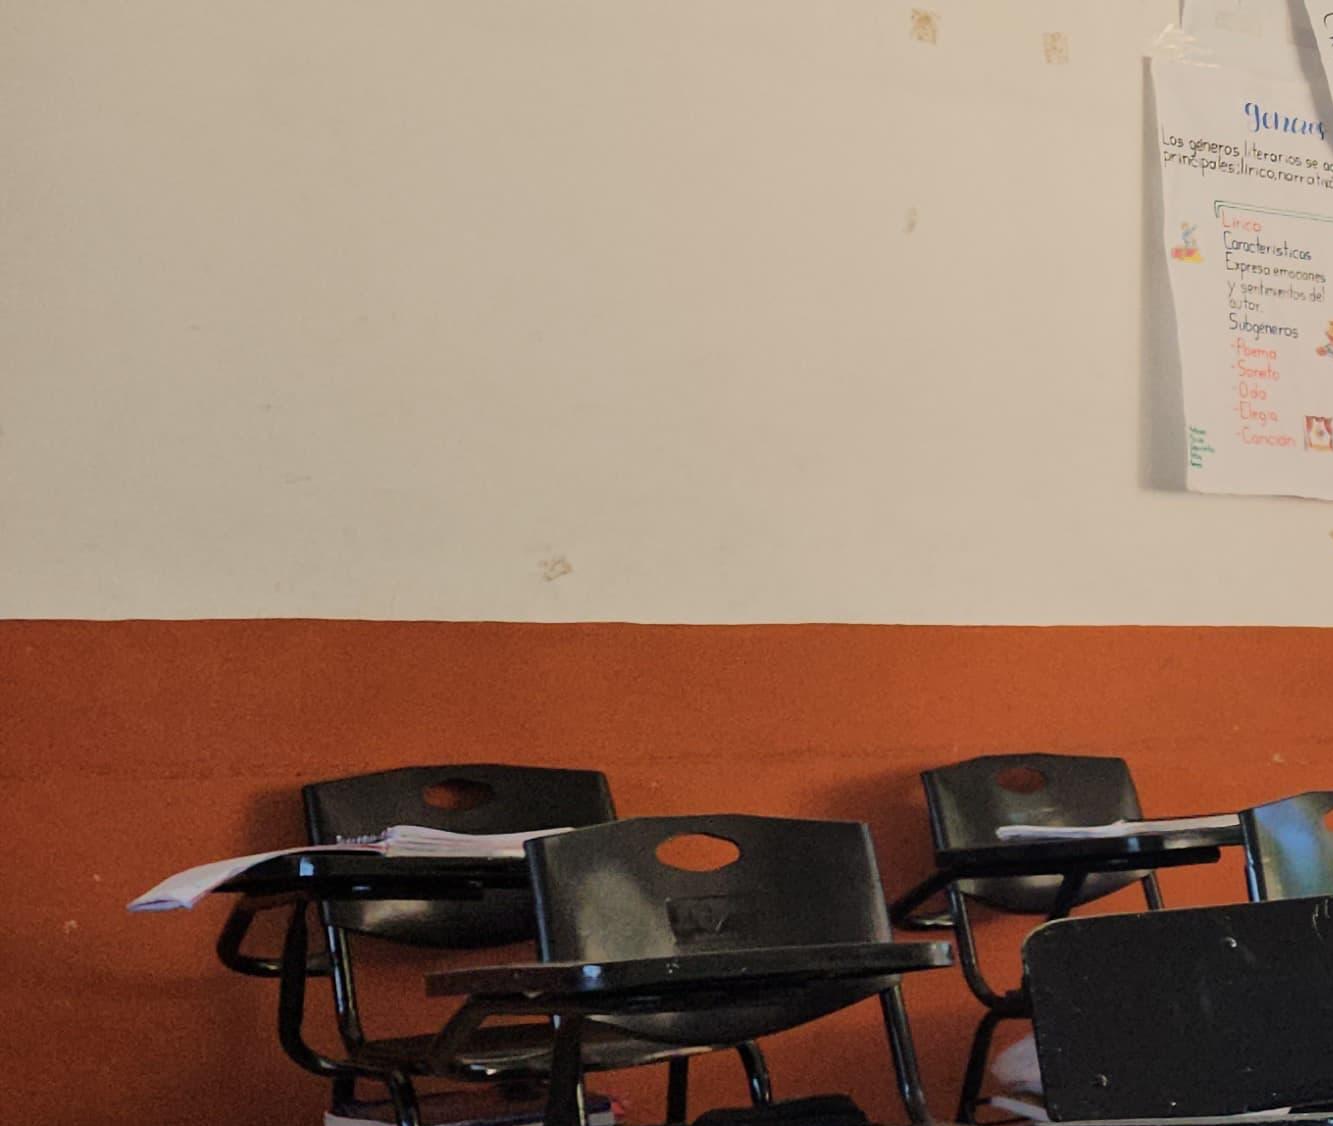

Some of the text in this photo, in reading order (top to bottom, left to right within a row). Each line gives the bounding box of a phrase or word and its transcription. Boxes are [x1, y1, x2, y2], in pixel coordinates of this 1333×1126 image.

[1162, 125, 1184, 148] Los
[1244, 140, 1302, 167] literarios
[1306, 157, 1319, 169] se
[1226, 251, 1271, 280] Expresa
[1227, 280, 1237, 299] y
